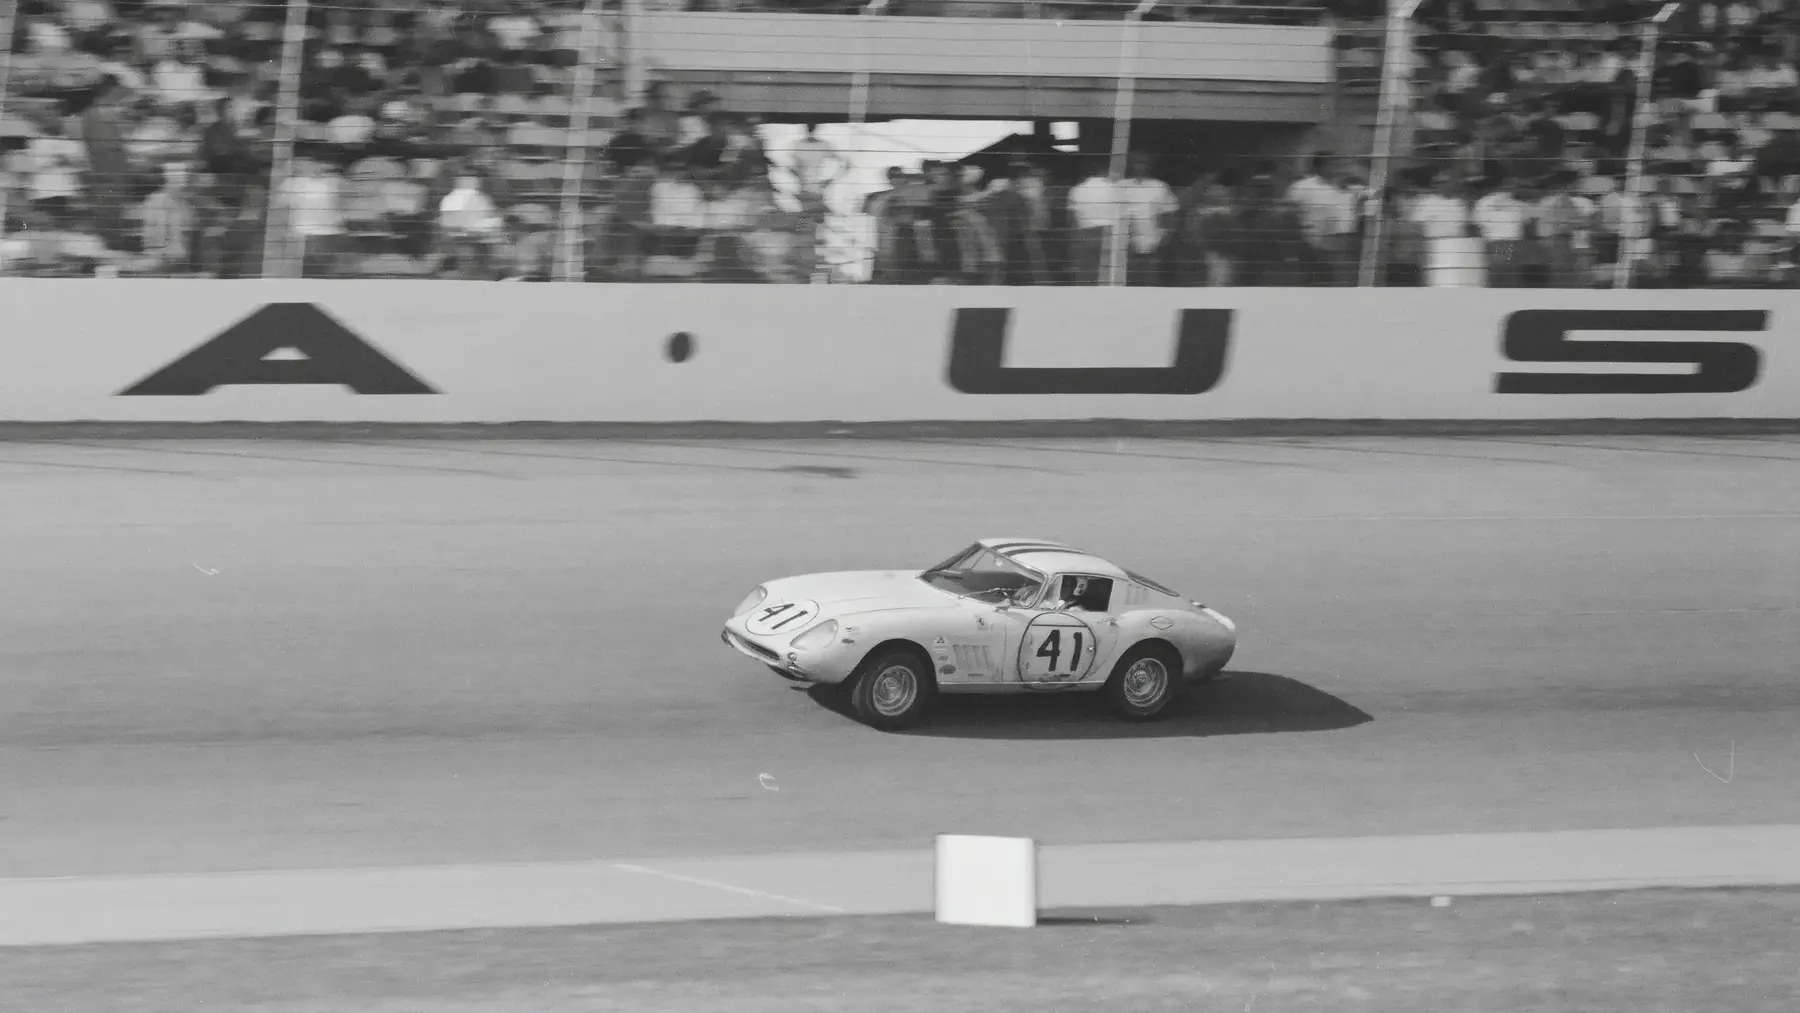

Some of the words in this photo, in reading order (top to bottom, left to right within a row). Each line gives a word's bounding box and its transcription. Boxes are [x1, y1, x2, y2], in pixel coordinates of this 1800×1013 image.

[115, 302, 444, 397] A
[758, 603, 809, 630] 41
[1036, 629, 1083, 672] 41
